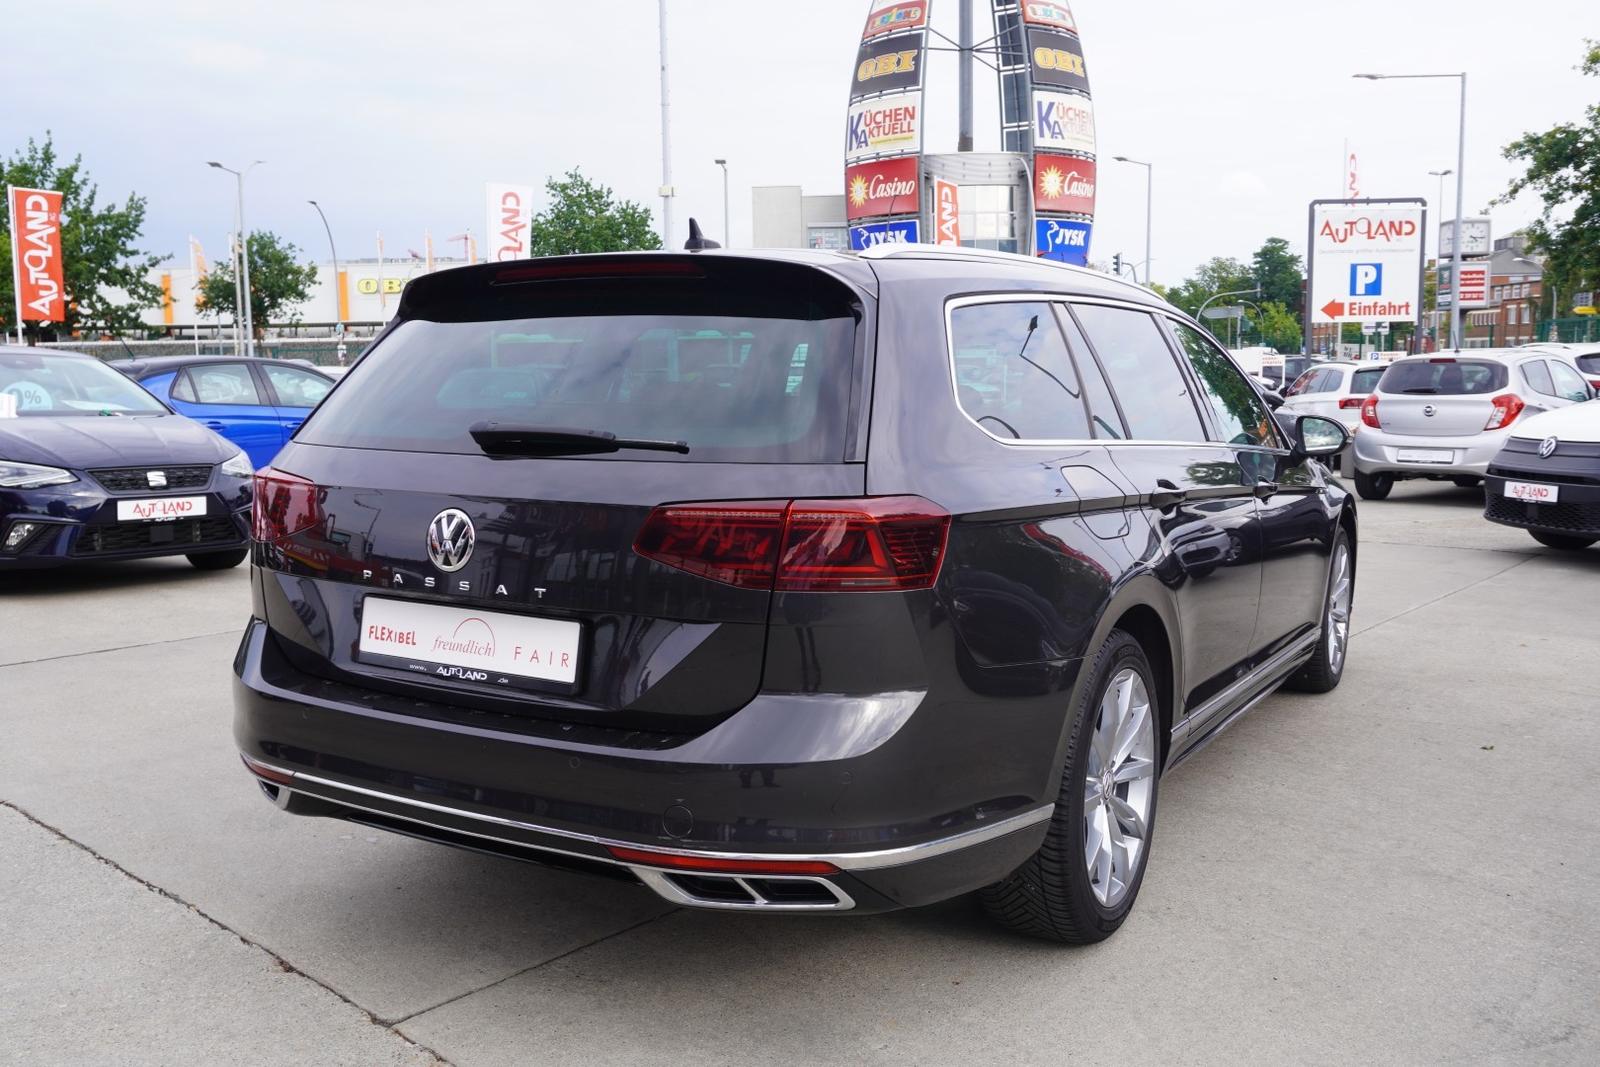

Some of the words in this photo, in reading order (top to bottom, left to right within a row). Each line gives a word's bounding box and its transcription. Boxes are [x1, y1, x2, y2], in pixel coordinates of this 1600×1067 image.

[857, 49, 918, 82] OBI
[1034, 47, 1085, 78] OBI
[849, 106, 916, 151] KÜCHEN
[869, 174, 916, 200] Casino
[1063, 171, 1095, 198] Casino
[1055, 229, 1086, 247] JYSK
[1320, 217, 1416, 243] AUTOLAND
[1355, 264, 1378, 295] P
[1348, 301, 1411, 316] Einfahrt
[362, 569, 547, 598] PASSAT
[431, 635, 493, 657] freundlich
[513, 646, 570, 668] FAIR
[436, 666, 488, 681] AUTOLAND
